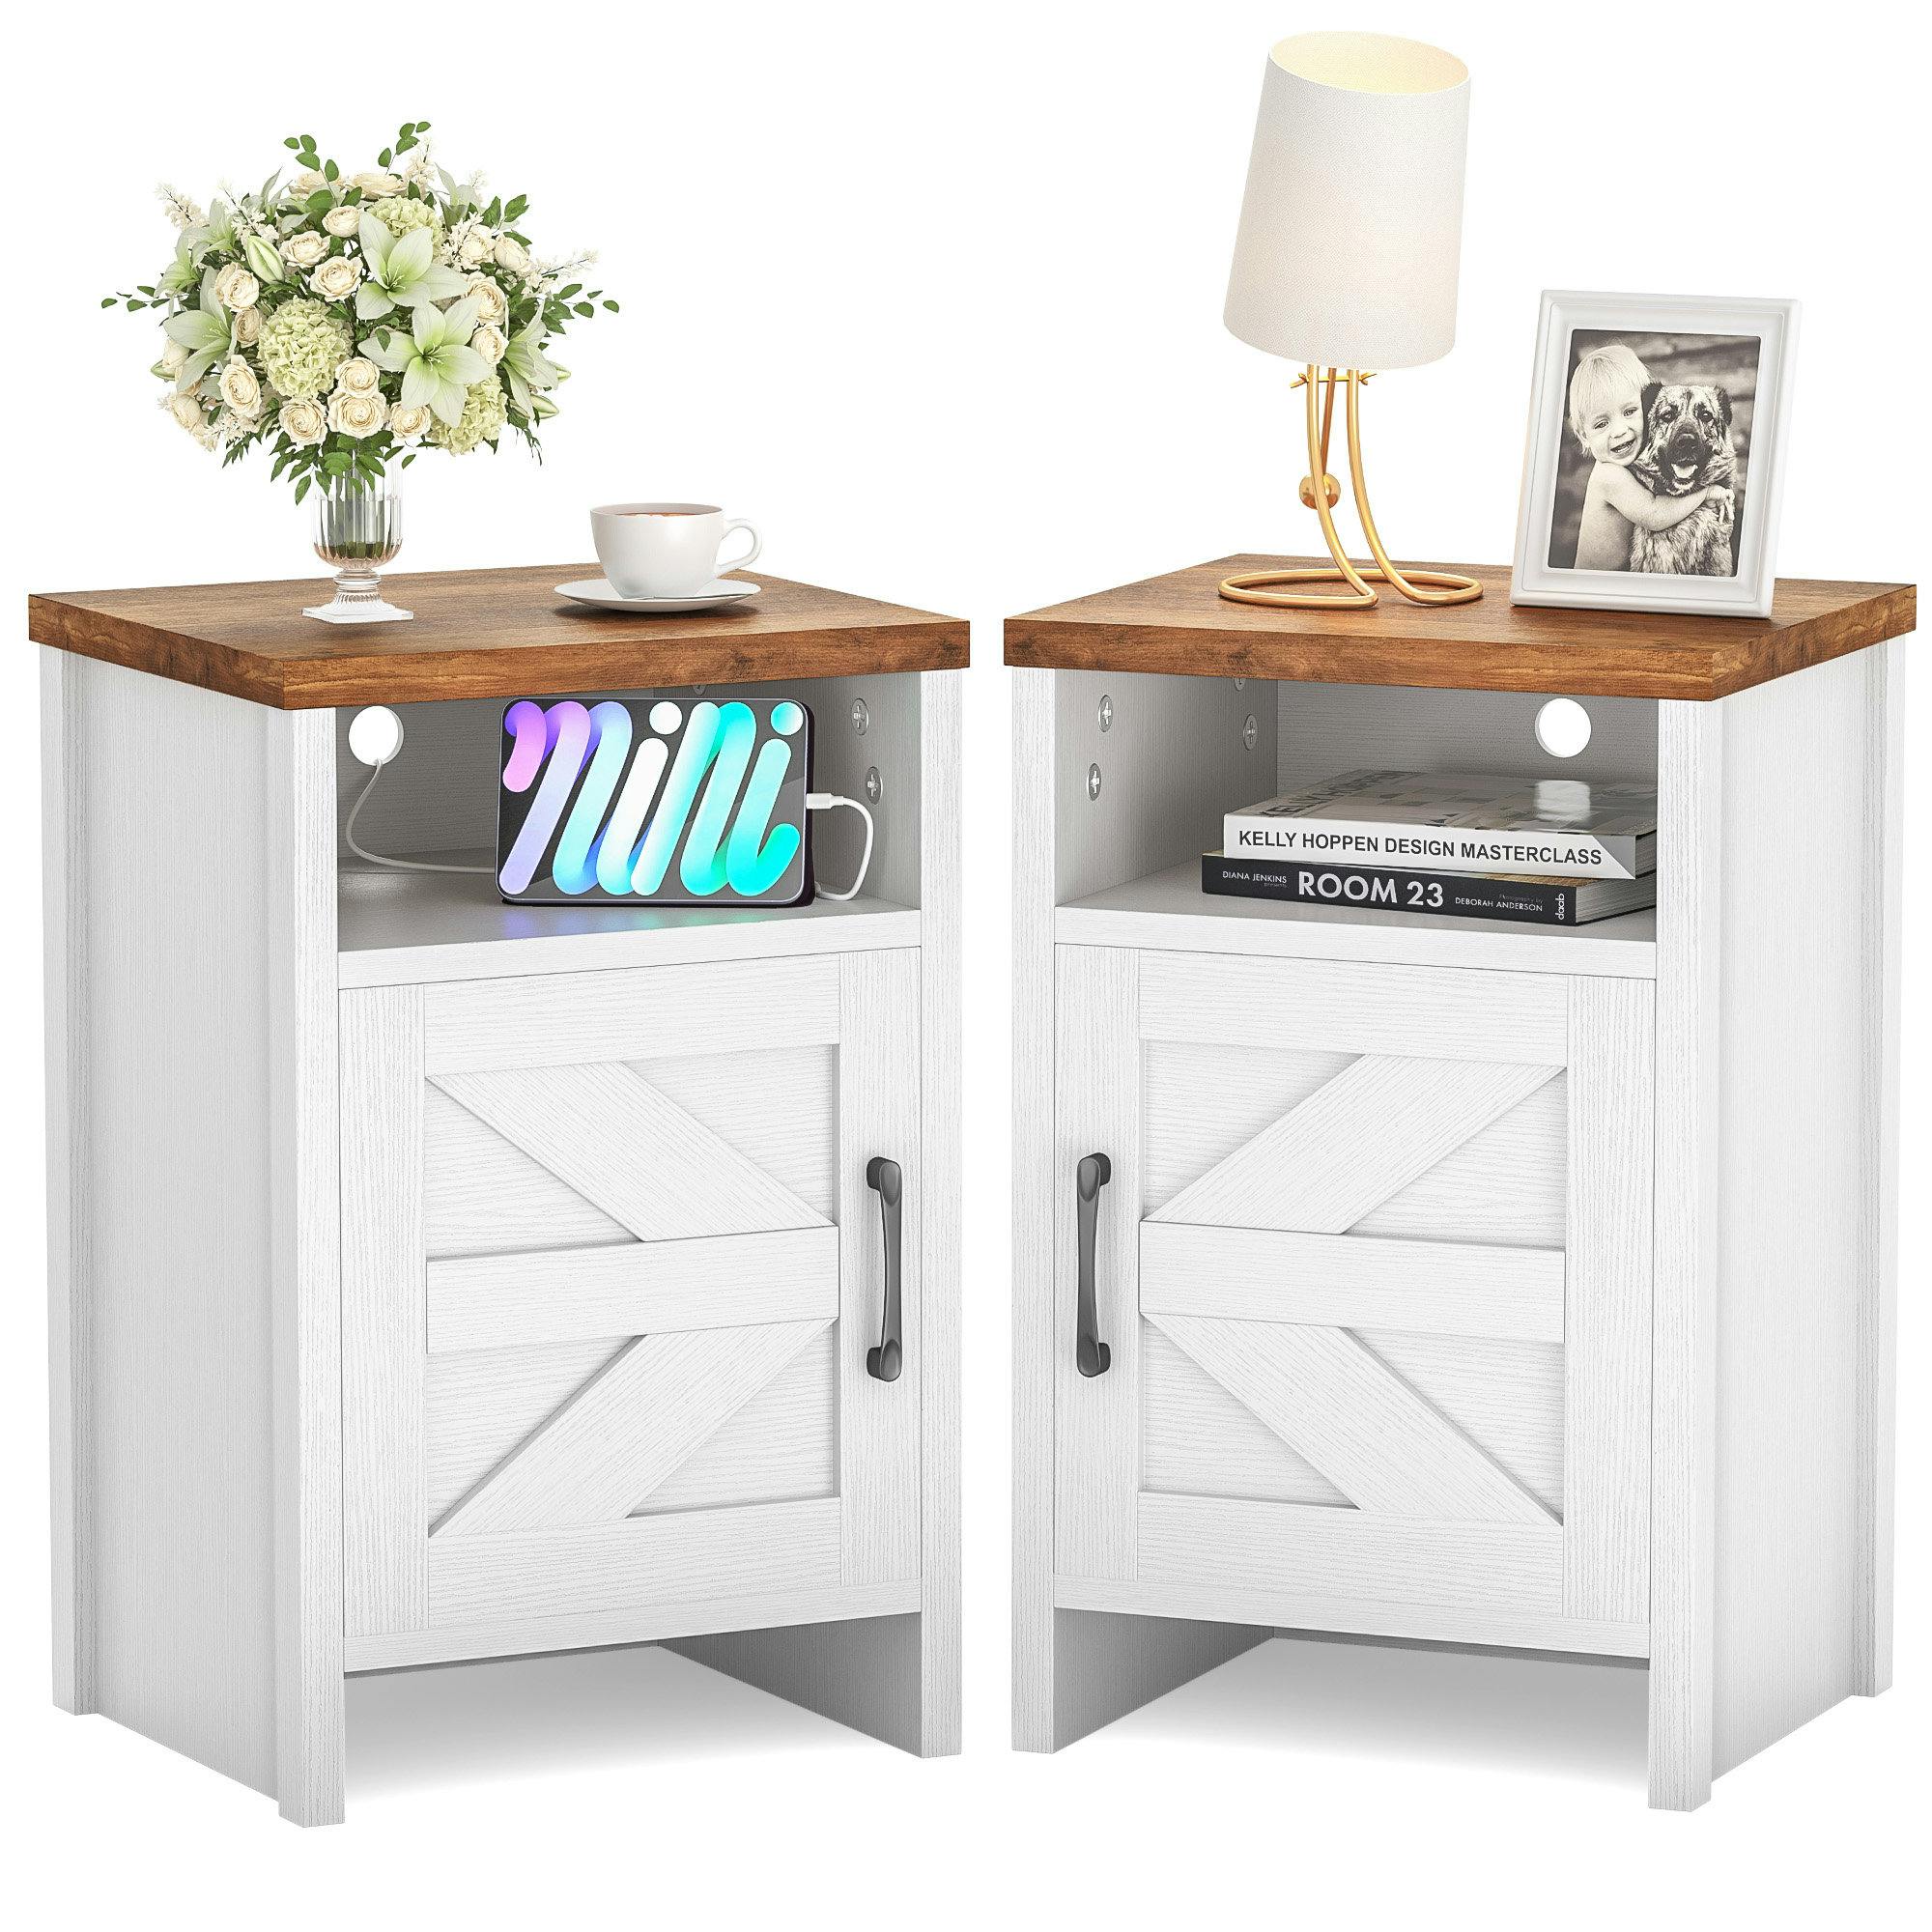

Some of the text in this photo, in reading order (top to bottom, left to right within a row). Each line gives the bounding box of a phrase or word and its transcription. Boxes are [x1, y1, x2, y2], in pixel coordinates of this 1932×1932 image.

[1238, 831, 1603, 865] KELLY HOPPEN DESIGN MASTERCLASS
[1222, 870, 1288, 884] DIANA JENKINS
[1298, 871, 1444, 908] ROOM 23
[1455, 896, 1543, 912] DEBORAH ANDERSON
[1554, 893, 1565, 921] daab
